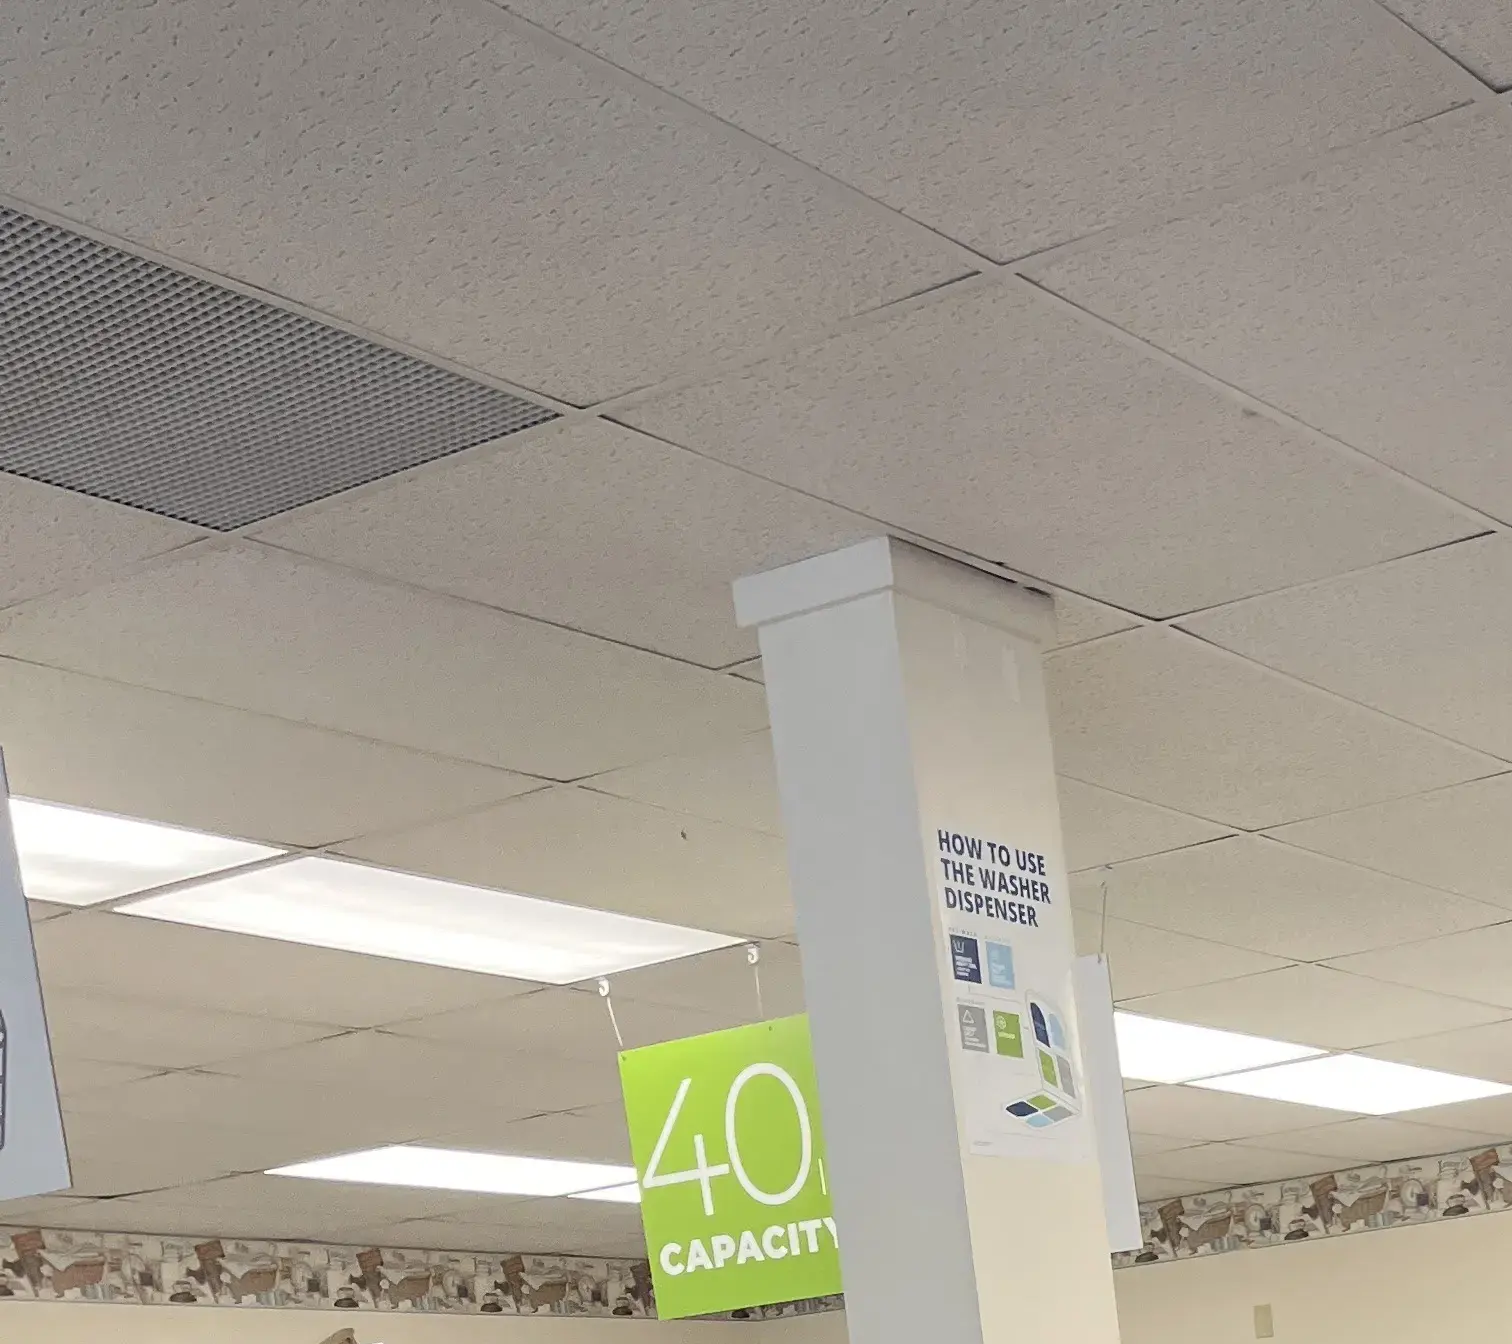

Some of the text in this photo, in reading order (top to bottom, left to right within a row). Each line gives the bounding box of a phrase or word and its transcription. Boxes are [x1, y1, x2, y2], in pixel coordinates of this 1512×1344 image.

[937, 829, 1046, 876] HOW TO USE
[940, 858, 1051, 904] THE WASHER
[944, 887, 1038, 927] DISPENSER
[642, 1062, 812, 1216] 40
